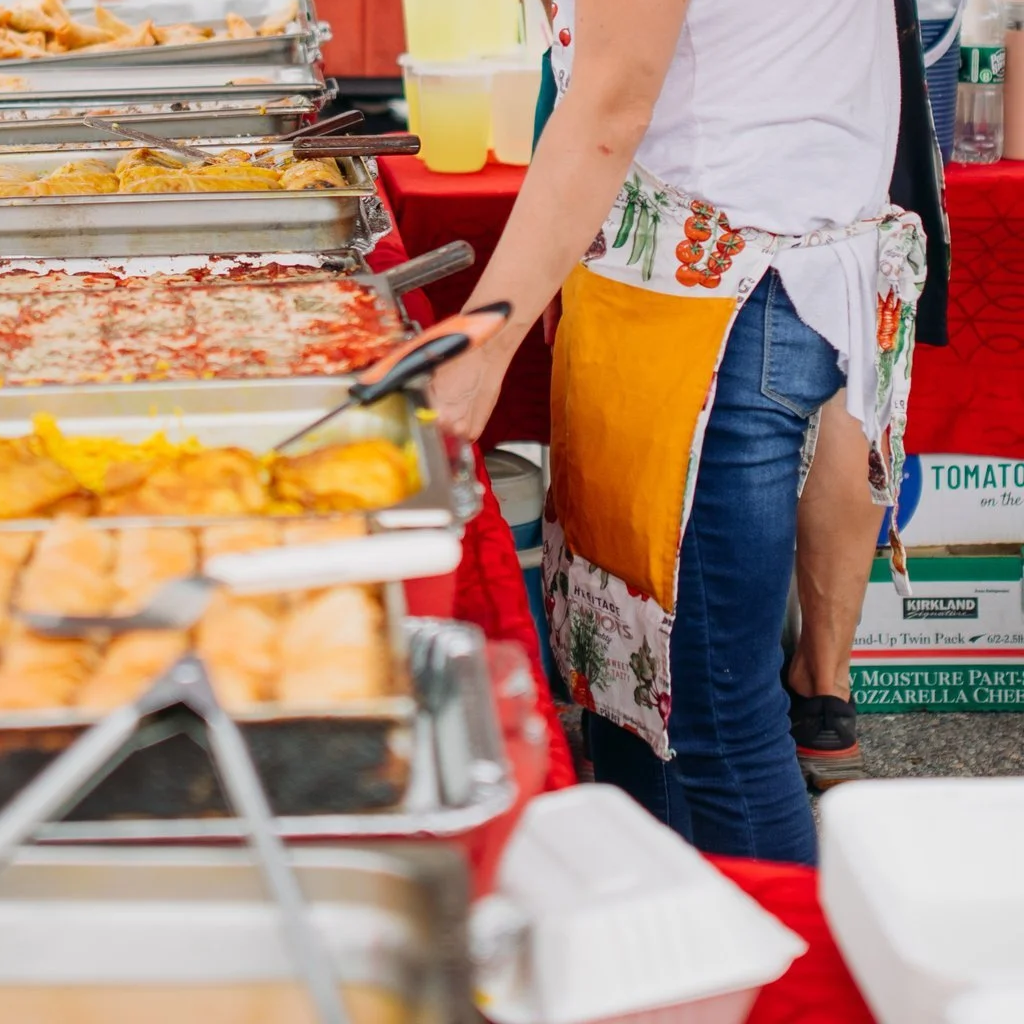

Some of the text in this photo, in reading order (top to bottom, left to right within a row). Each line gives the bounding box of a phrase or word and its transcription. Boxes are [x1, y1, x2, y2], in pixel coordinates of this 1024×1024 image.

[980, 491, 1023, 507] on the
[907, 599, 976, 611] KIRKLAND
[907, 610, 968, 619] Signature
[853, 632, 897, 647] and-Up
[899, 632, 931, 645] Twin
[935, 632, 965, 645] Pack
[861, 670, 964, 686] MOISTURE
[968, 669, 1024, 686] PART-
[851, 688, 968, 704] OZZARELLA
